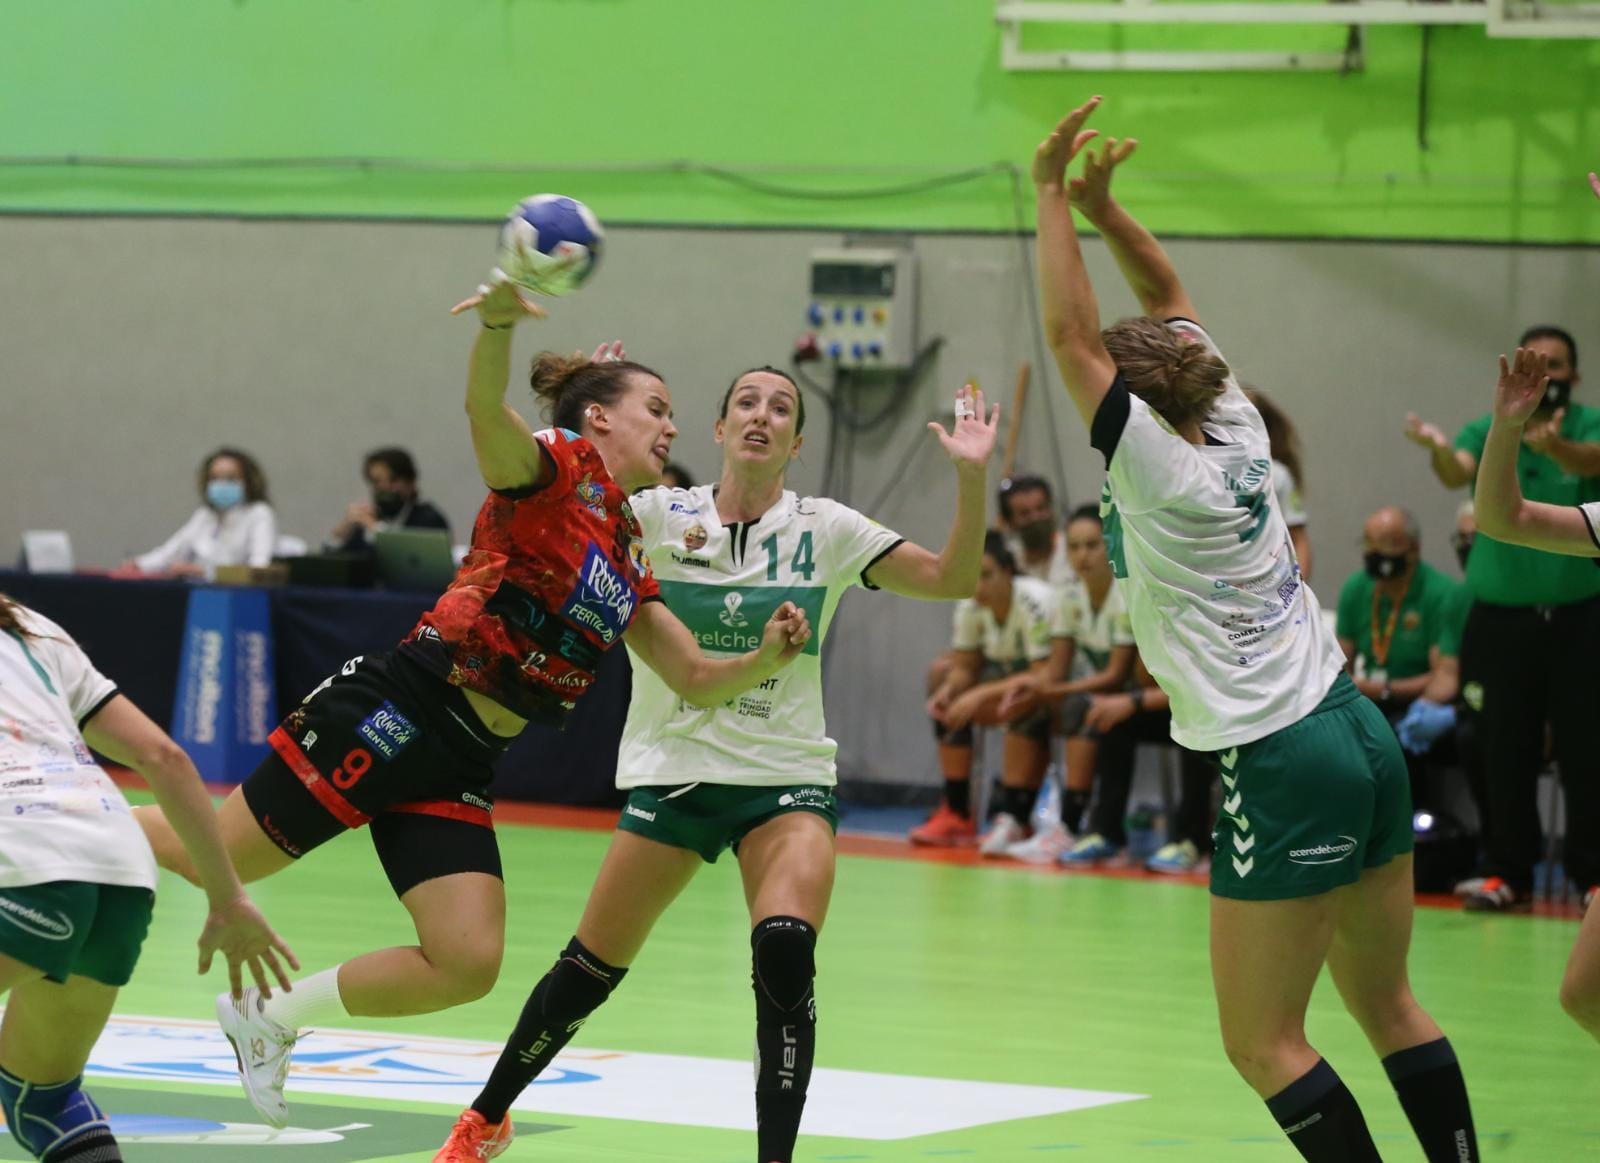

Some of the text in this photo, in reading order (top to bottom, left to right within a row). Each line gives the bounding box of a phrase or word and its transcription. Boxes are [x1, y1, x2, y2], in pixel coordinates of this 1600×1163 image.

[671, 551, 711, 568] hummel
[761, 529, 816, 581] 14
[691, 631, 760, 650] telche
[1227, 625, 1267, 641] COMELZ
[737, 709, 770, 720] ALFONSO
[739, 702, 771, 713] TRINIDAD
[361, 724, 394, 757] DENTAL
[332, 748, 373, 790] 9
[626, 803, 657, 823] hummel
